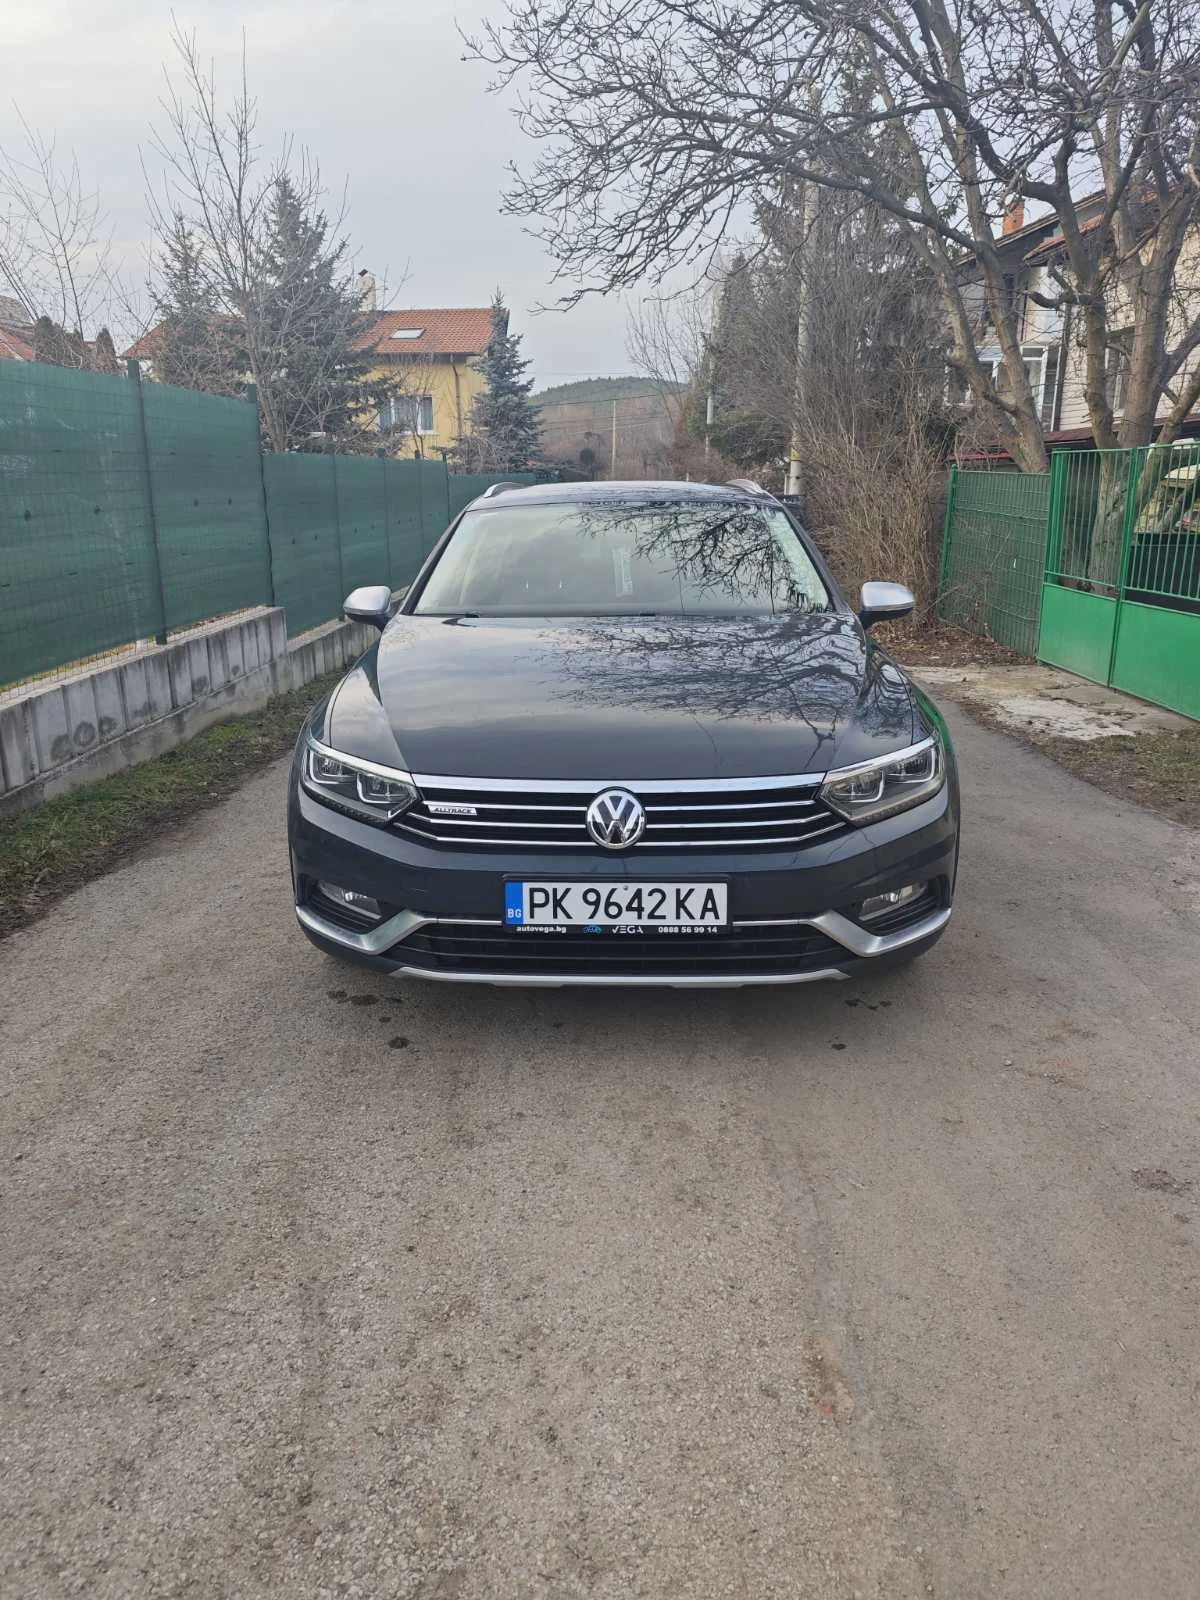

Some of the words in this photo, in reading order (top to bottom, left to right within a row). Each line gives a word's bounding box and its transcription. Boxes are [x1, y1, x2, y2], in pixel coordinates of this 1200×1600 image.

[528, 887, 573, 920] PK
[581, 887, 667, 920] 9642
[675, 887, 721, 920] KA
[507, 908, 522, 918] BG
[516, 925, 567, 934] autovega.bg
[611, 925, 644, 934] VEGA
[658, 926, 680, 934] 0888
[681, 926, 692, 934] 56
[707, 926, 718, 934] 14
